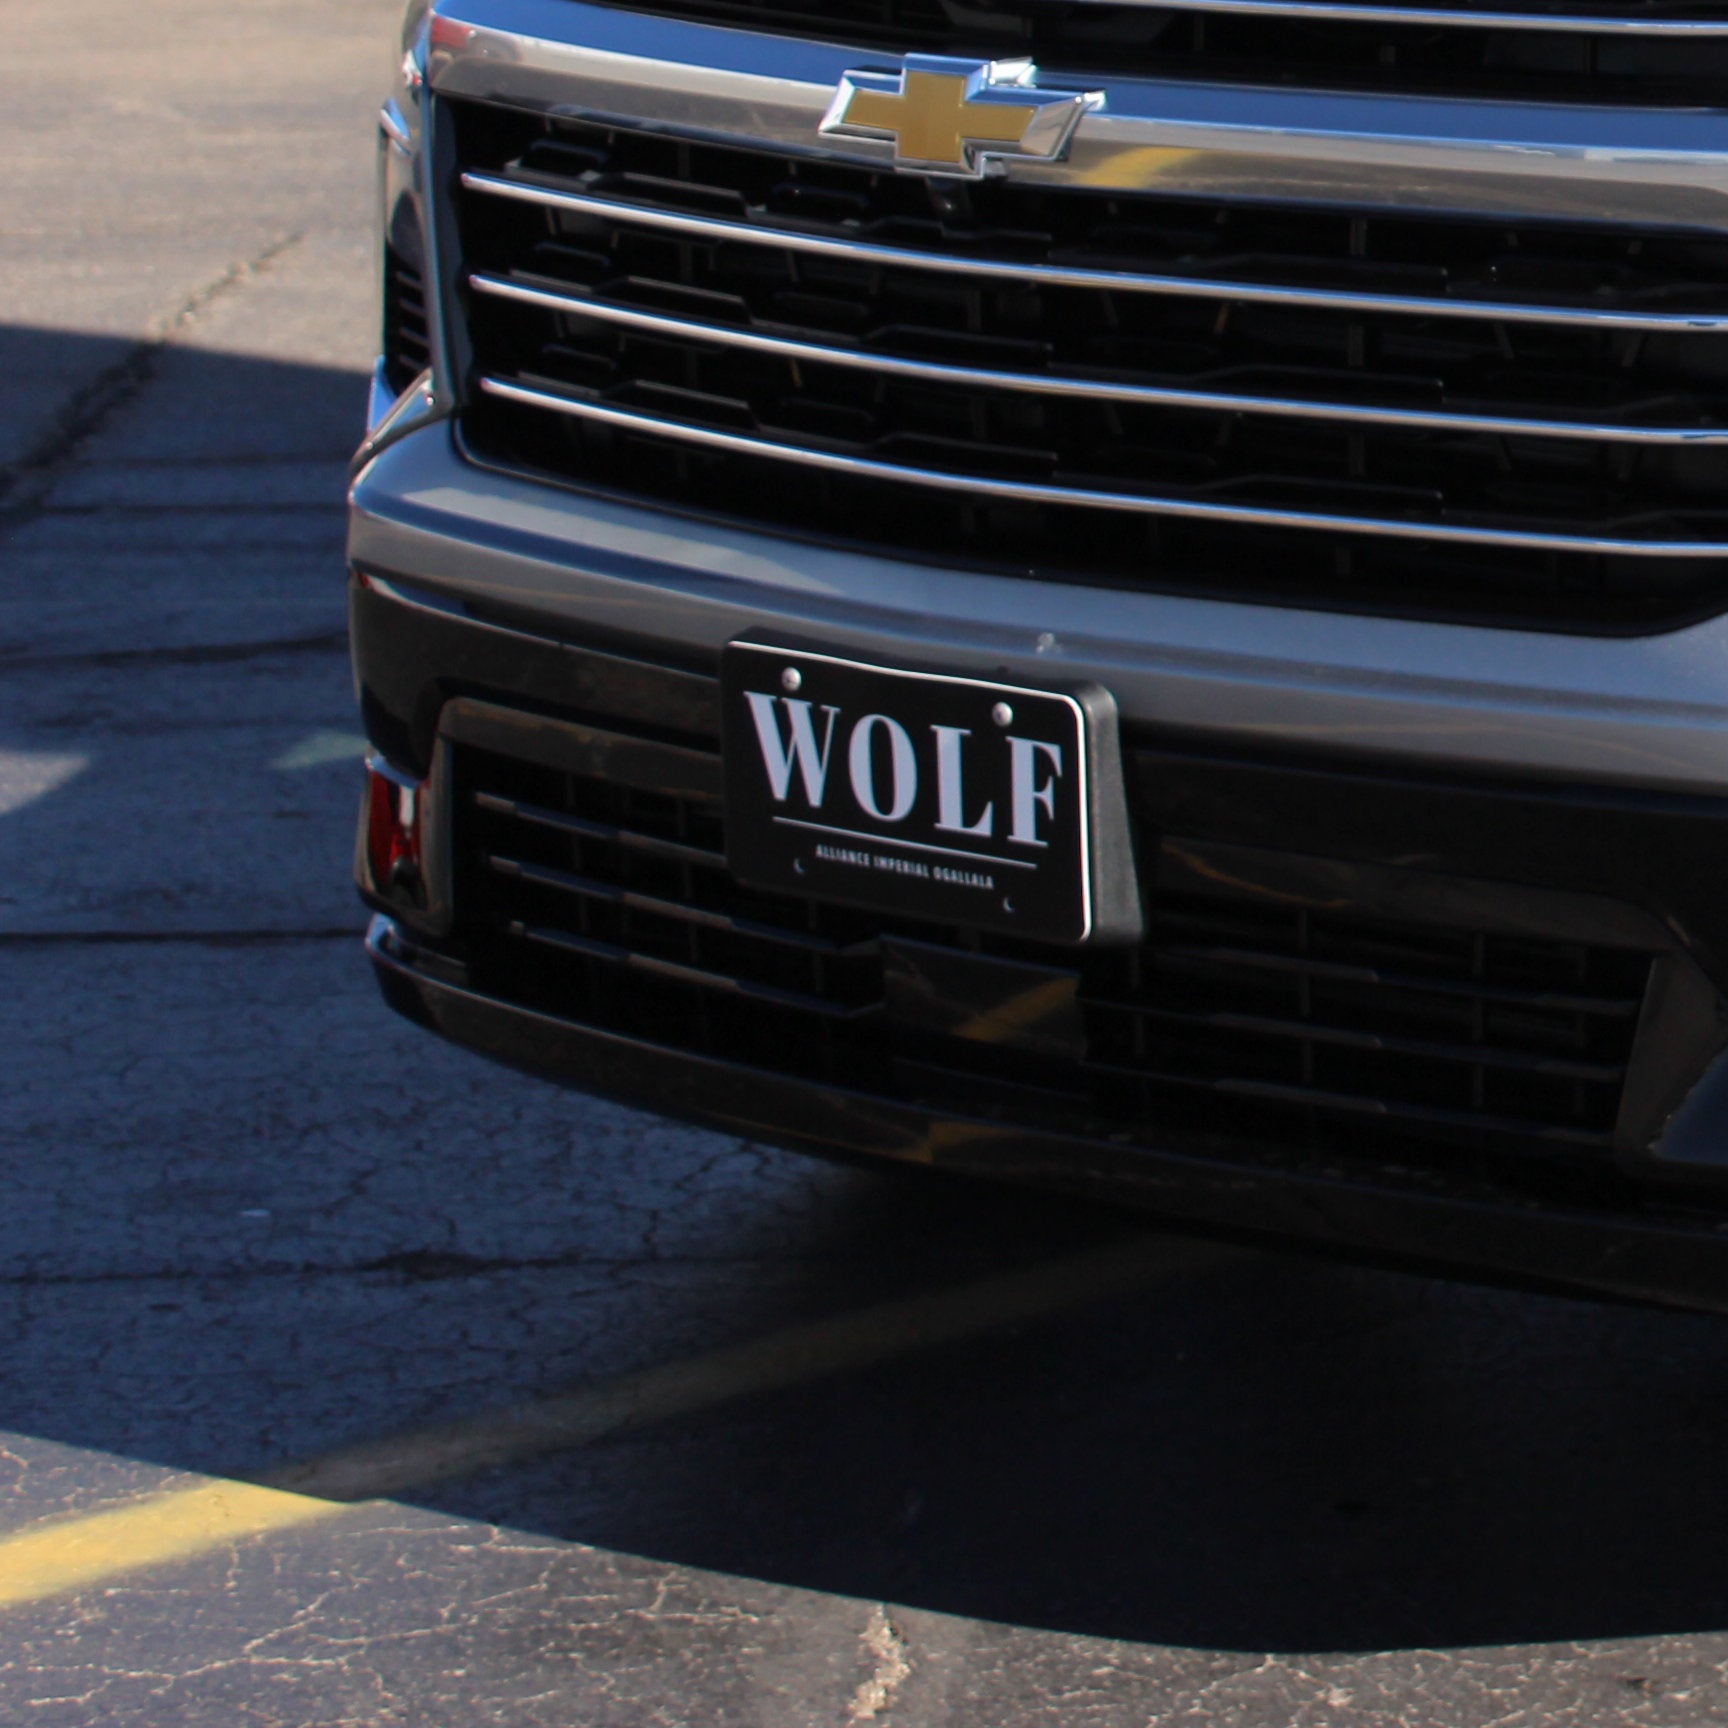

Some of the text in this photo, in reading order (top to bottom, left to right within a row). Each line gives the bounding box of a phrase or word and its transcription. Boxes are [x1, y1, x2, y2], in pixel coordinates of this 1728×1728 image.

[744, 690, 1063, 848] WOLF
[815, 844, 994, 889] ALLIANCE IMPERIAL OGALLALA
